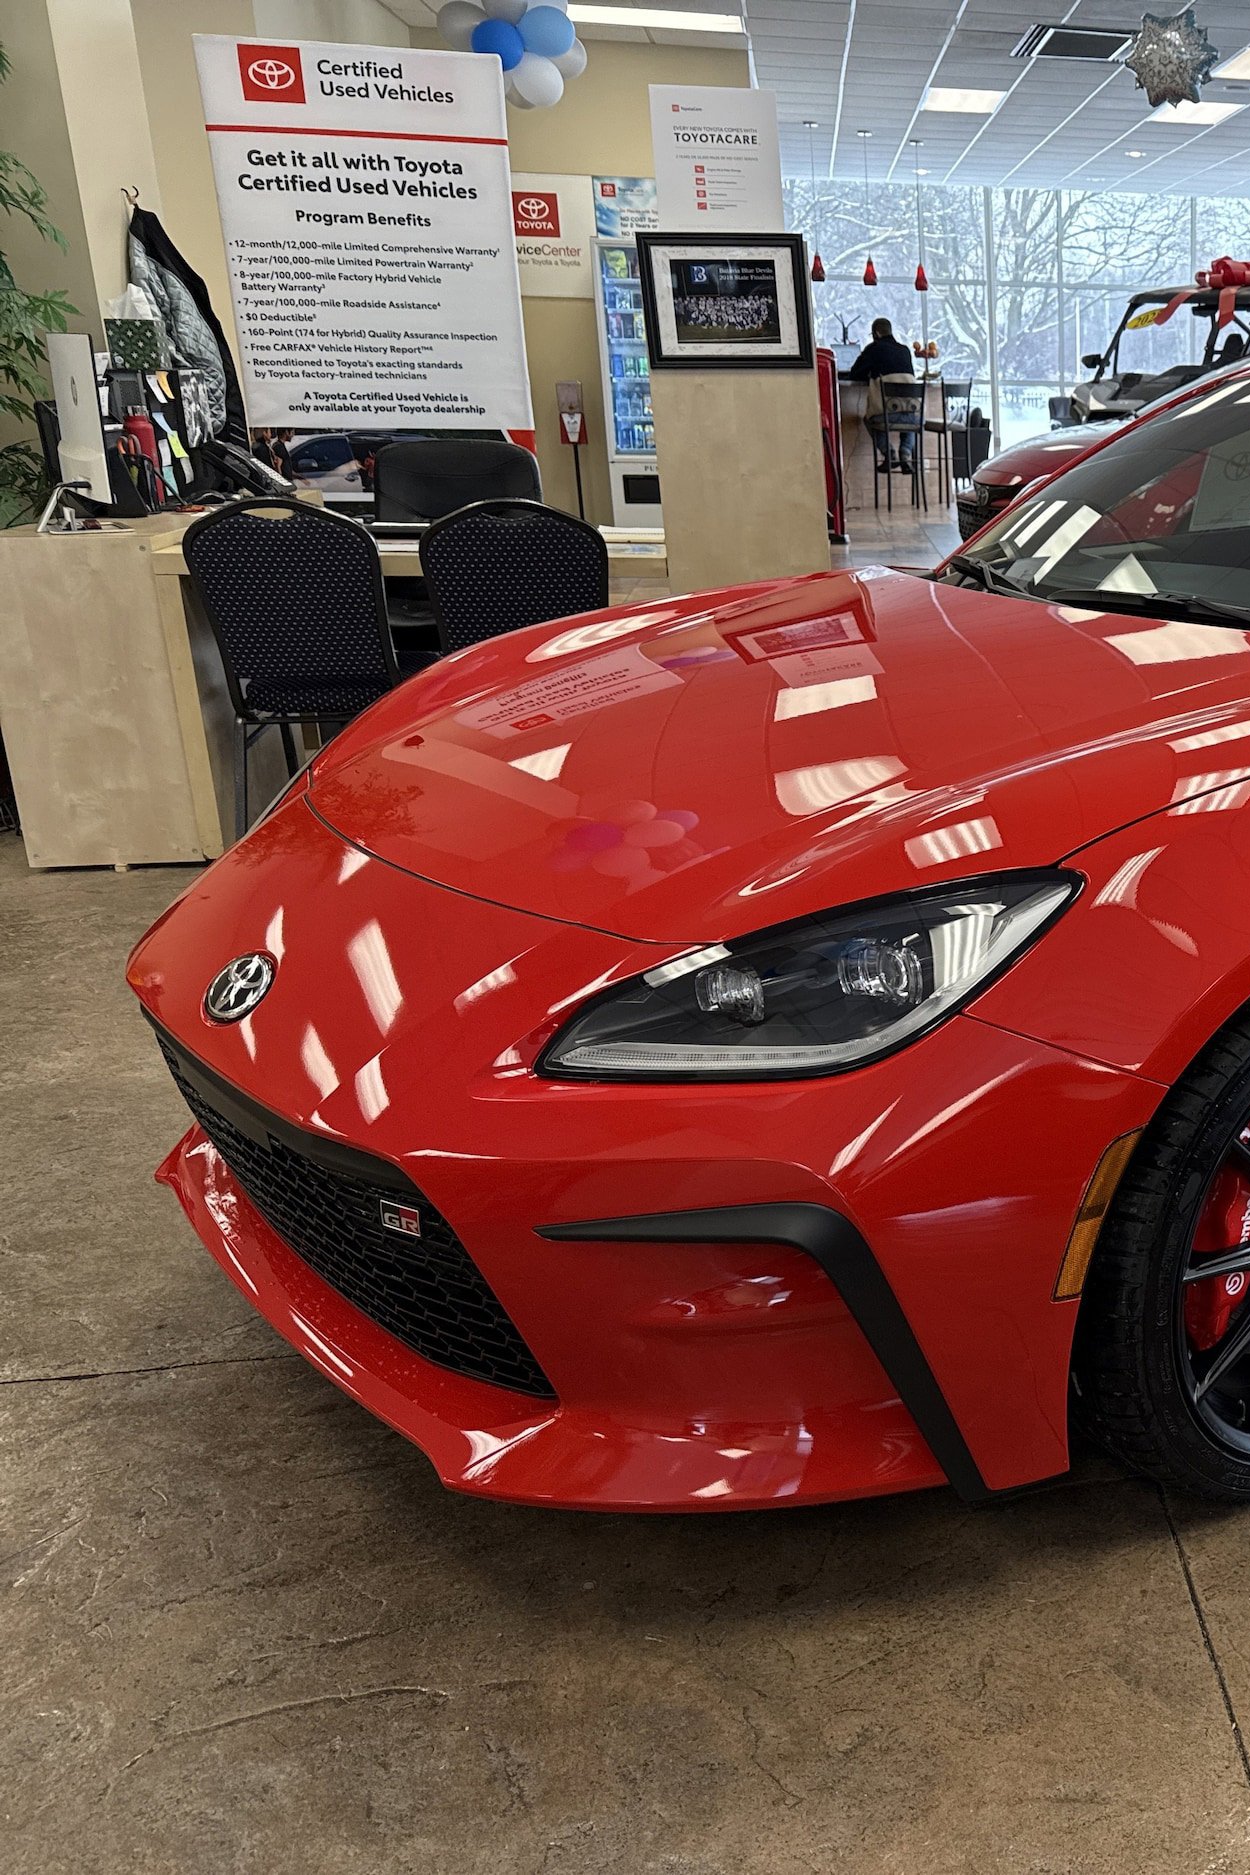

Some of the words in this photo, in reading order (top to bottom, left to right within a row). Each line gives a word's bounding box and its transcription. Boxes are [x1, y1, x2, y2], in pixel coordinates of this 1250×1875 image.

[317, 59, 402, 79] Certified
[320, 81, 370, 98] Used
[376, 84, 454, 104] Vehicles
[674, 132, 758, 145] TOYOTACARE
[247, 150, 286, 168] Get
[291, 152, 307, 169] it
[312, 153, 339, 170] all
[343, 155, 390, 172] with
[394, 156, 463, 177] Toyota
[238, 173, 332, 193] Certified
[336, 177, 389, 197] Used
[392, 180, 478, 201] Vehicles
[295, 209, 364, 230] Program
[368, 213, 432, 228] Benefits
[516, 220, 554, 230] TOYOTA
[234, 240, 342, 251] 12-month/12,000-mile
[344, 242, 380, 252] Limited
[381, 243, 454, 255] Comprehensive
[516, 243, 582, 257] viceCenter
[237, 255, 336, 266] 7-year/100,000-mile
[337, 257, 373, 267] Limited
[375, 258, 426, 269] Powertrain
[239, 270, 337, 281] 8-year/100,000-mile
[338, 272, 373, 283] Factory
[375, 274, 407, 284] Hybrid
[408, 275, 442, 284] Vehicle
[241, 282, 276, 292] Battery
[243, 298, 341, 308] 7-year/100,000-mile
[343, 299, 387, 309] Roadside
[246, 312, 258, 321] $0
[248, 328, 293, 337] 160-Point
[295, 328, 315, 338] (174
[316, 329, 330, 338] for
[331, 329, 366, 339] Hybrid)
[368, 330, 402, 340] Quality
[403, 330, 449, 340] Assurance
[451, 332, 498, 342] Inspection
[250, 343, 272, 352] Free
[318, 344, 352, 352] Vehicle
[354, 344, 388, 354] History
[253, 358, 322, 367] Reconditioned
[324, 359, 335, 368] to
[336, 359, 374, 369] Toyota's
[376, 360, 416, 370] exacting
[417, 360, 463, 370] standards
[254, 369, 267, 380] by
[268, 369, 300, 380] Toyota
[302, 369, 373, 380] factory-trained
[375, 371, 428, 380] technicians
[303, 391, 312, 400] A
[313, 391, 348, 402] Toyota
[349, 392, 394, 402] Certified
[395, 393, 421, 402] Used
[422, 393, 459, 402] Vehicle
[460, 393, 469, 402] is
[288, 403, 311, 414] only
[313, 403, 360, 413] available
[361, 404, 373, 413] at
[373, 405, 397, 414] your
[397, 404, 432, 415] Toyota
[433, 404, 486, 416] dealership
[383, 1211, 418, 1233] GR
